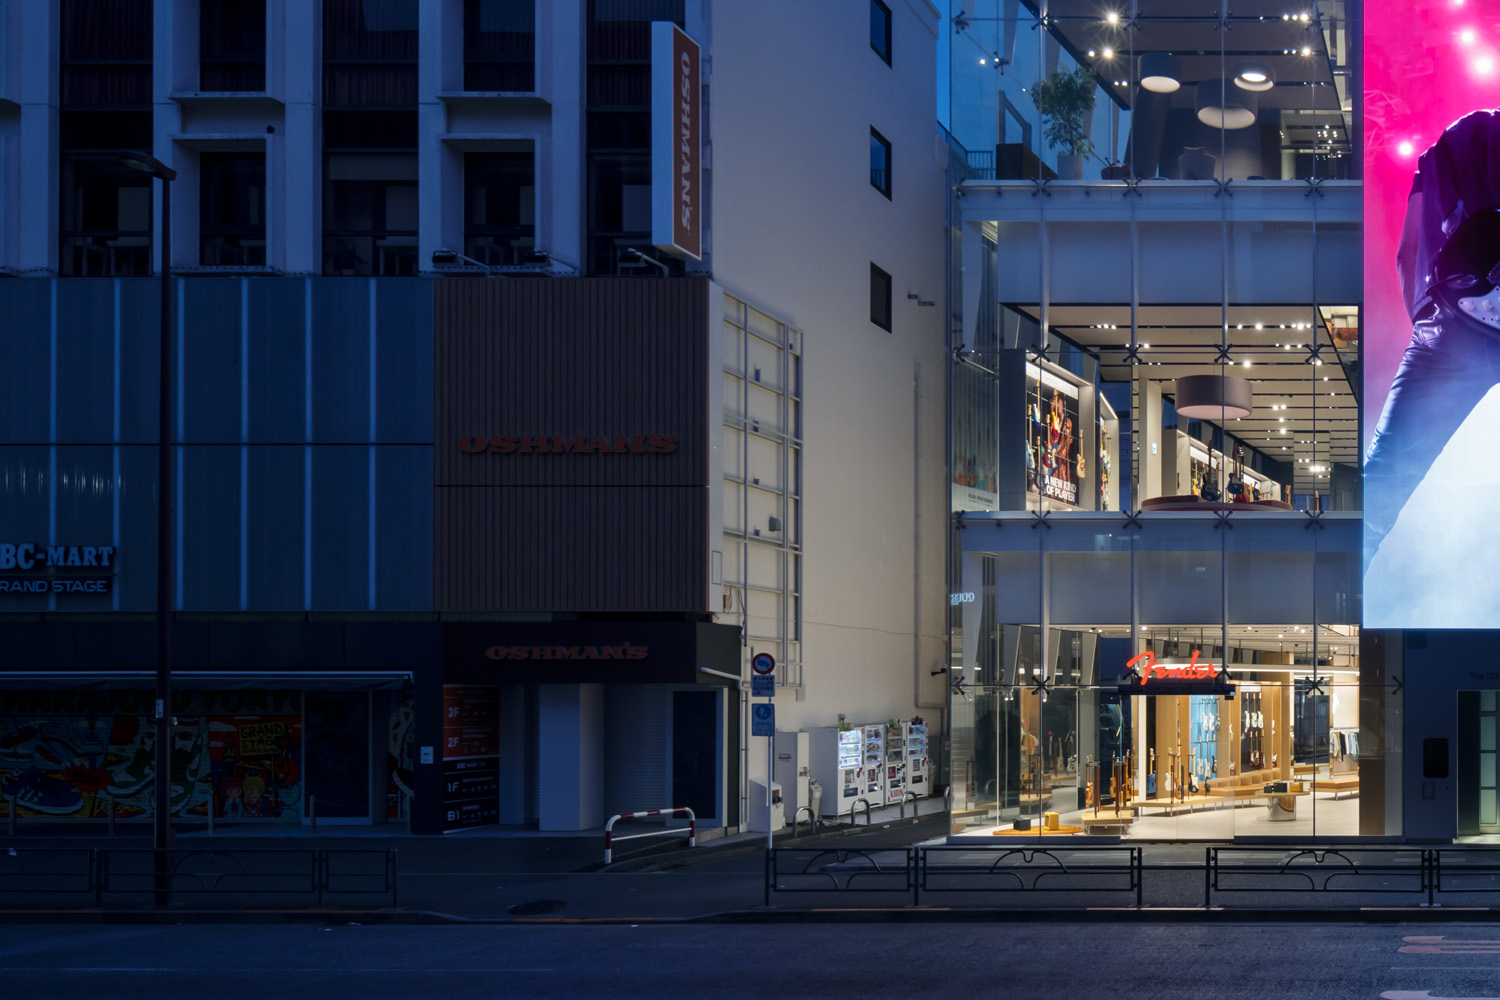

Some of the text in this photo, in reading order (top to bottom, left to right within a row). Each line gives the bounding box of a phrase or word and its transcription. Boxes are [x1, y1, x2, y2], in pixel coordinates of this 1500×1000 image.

[681, 51, 693, 231] OSHMAN'S
[459, 432, 679, 454] OSHMAN'S
[0, 543, 113, 570] BC-MART
[0, 580, 107, 593] RAND STAGE
[485, 642, 649, 661] OSHMAN'S
[1126, 649, 1218, 685] Fender
[240, 724, 283, 738] GRAND
[242, 736, 273, 749] STAG
